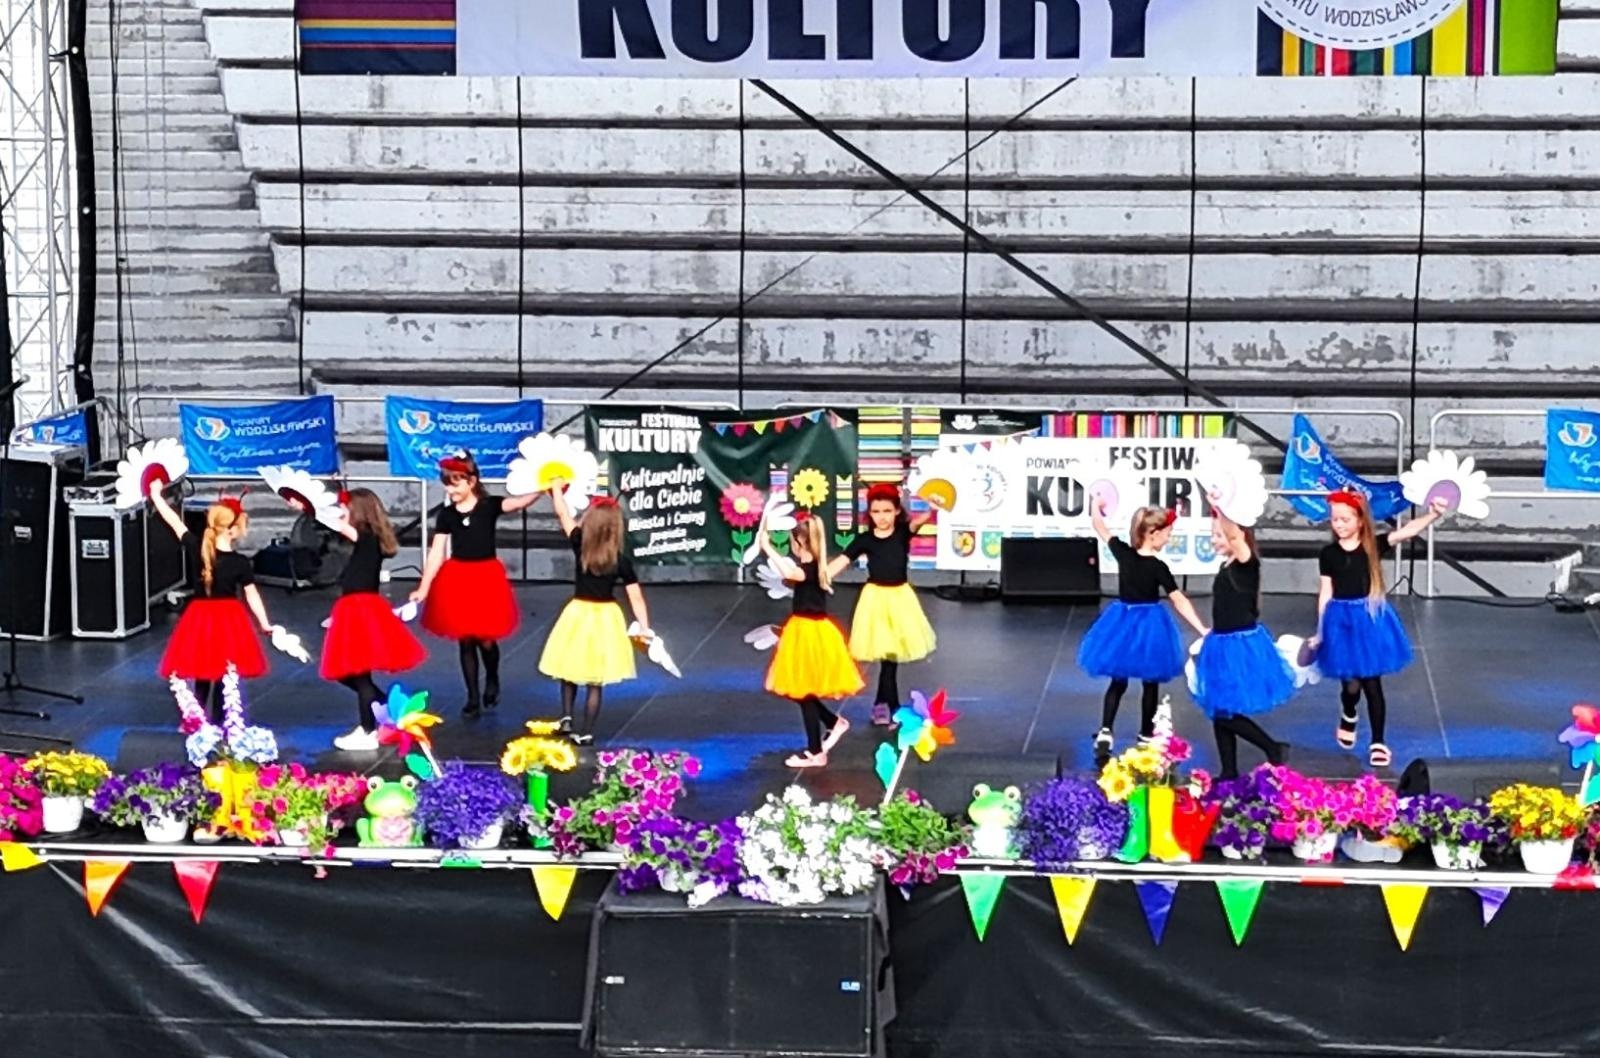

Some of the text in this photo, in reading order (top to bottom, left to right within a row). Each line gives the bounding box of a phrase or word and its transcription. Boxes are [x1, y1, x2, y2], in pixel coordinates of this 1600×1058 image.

[599, 428, 702, 454] KULTURY
[620, 463, 705, 492] Kulturalnie
[629, 485, 702, 511] dla Ciebie
